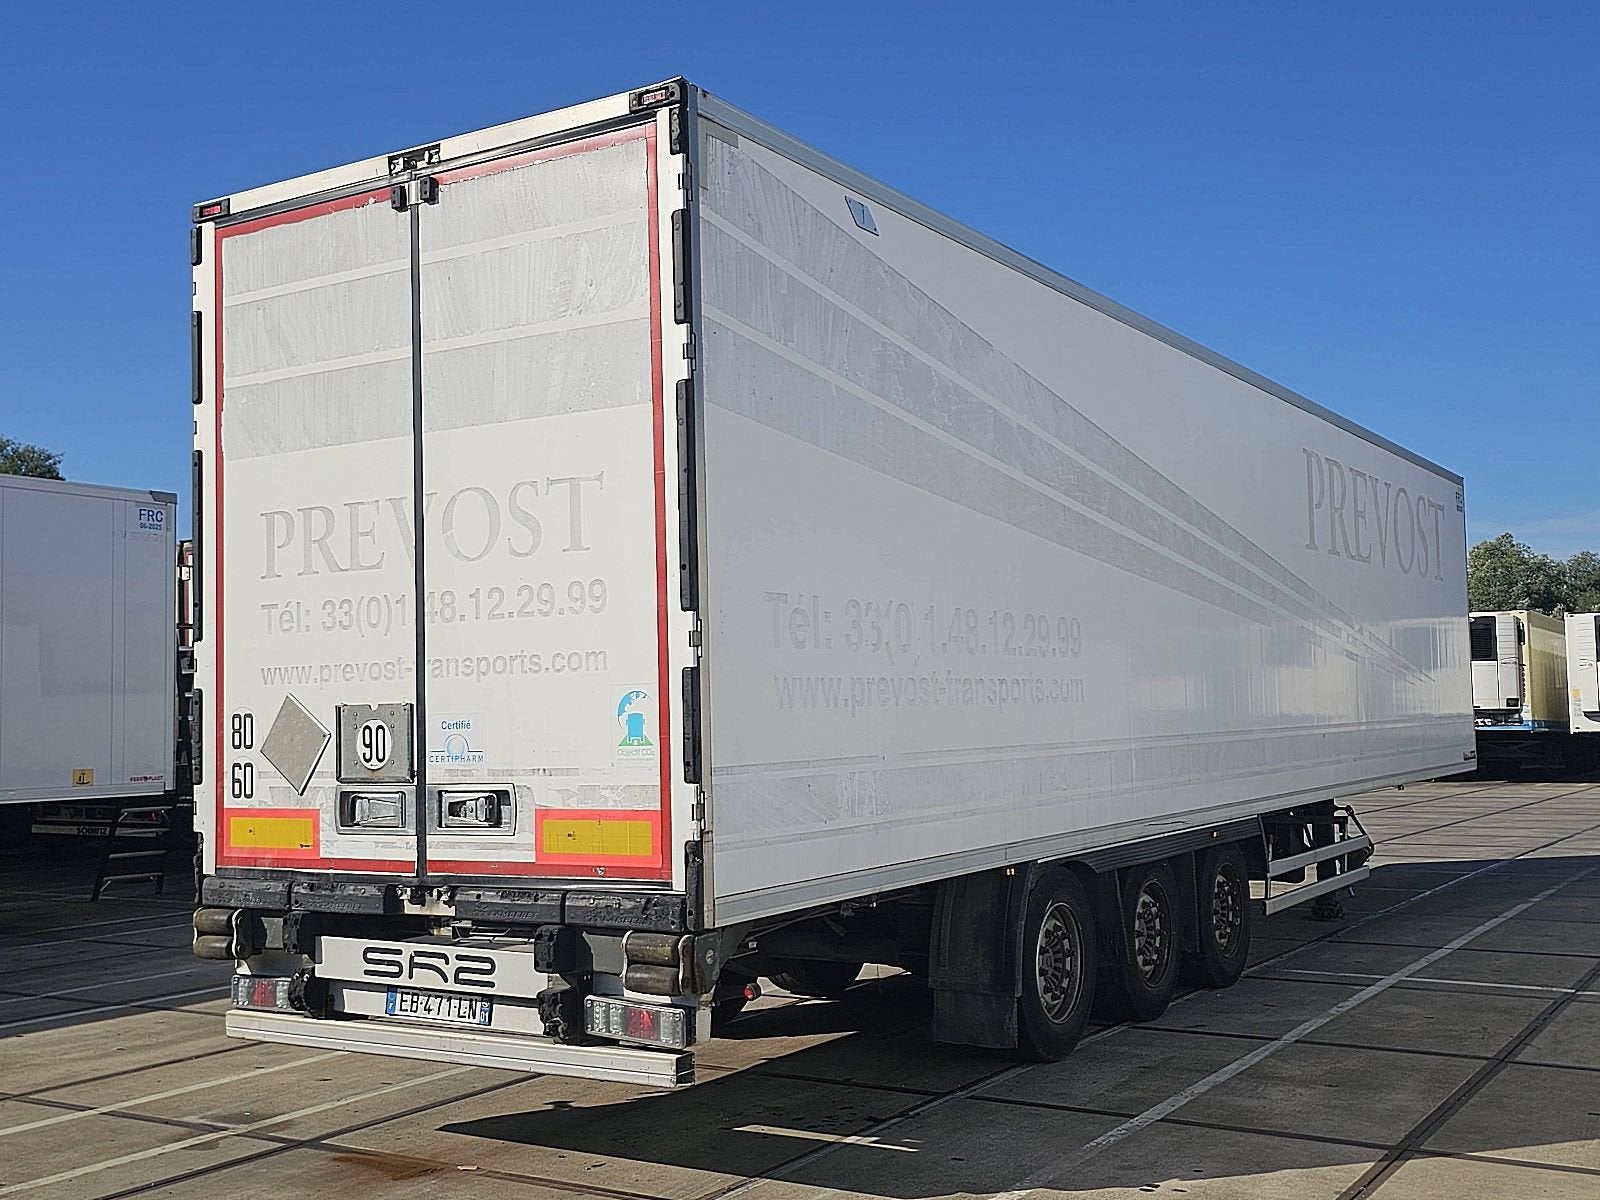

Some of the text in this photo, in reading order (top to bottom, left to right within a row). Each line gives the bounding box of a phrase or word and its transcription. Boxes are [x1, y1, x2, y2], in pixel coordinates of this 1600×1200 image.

[139, 508, 164, 522] FRC
[260, 470, 605, 580] PREVOST
[1302, 447, 1445, 582] PREVOST
[261, 579, 608, 638] Tél: 33(0)148.12.29.99
[260, 647, 608, 690] www.prevost-ransports.com
[773, 670, 1085, 720] www.prevost-transports.com
[231, 713, 254, 750] 80
[362, 724, 386, 763] 90
[441, 719, 471, 730] Certifié
[429, 754, 484, 763] CERTIPHARM
[231, 762, 254, 799] 60
[399, 991, 478, 1020] EB-471-LN
[481, 1011, 489, 1022] 01
